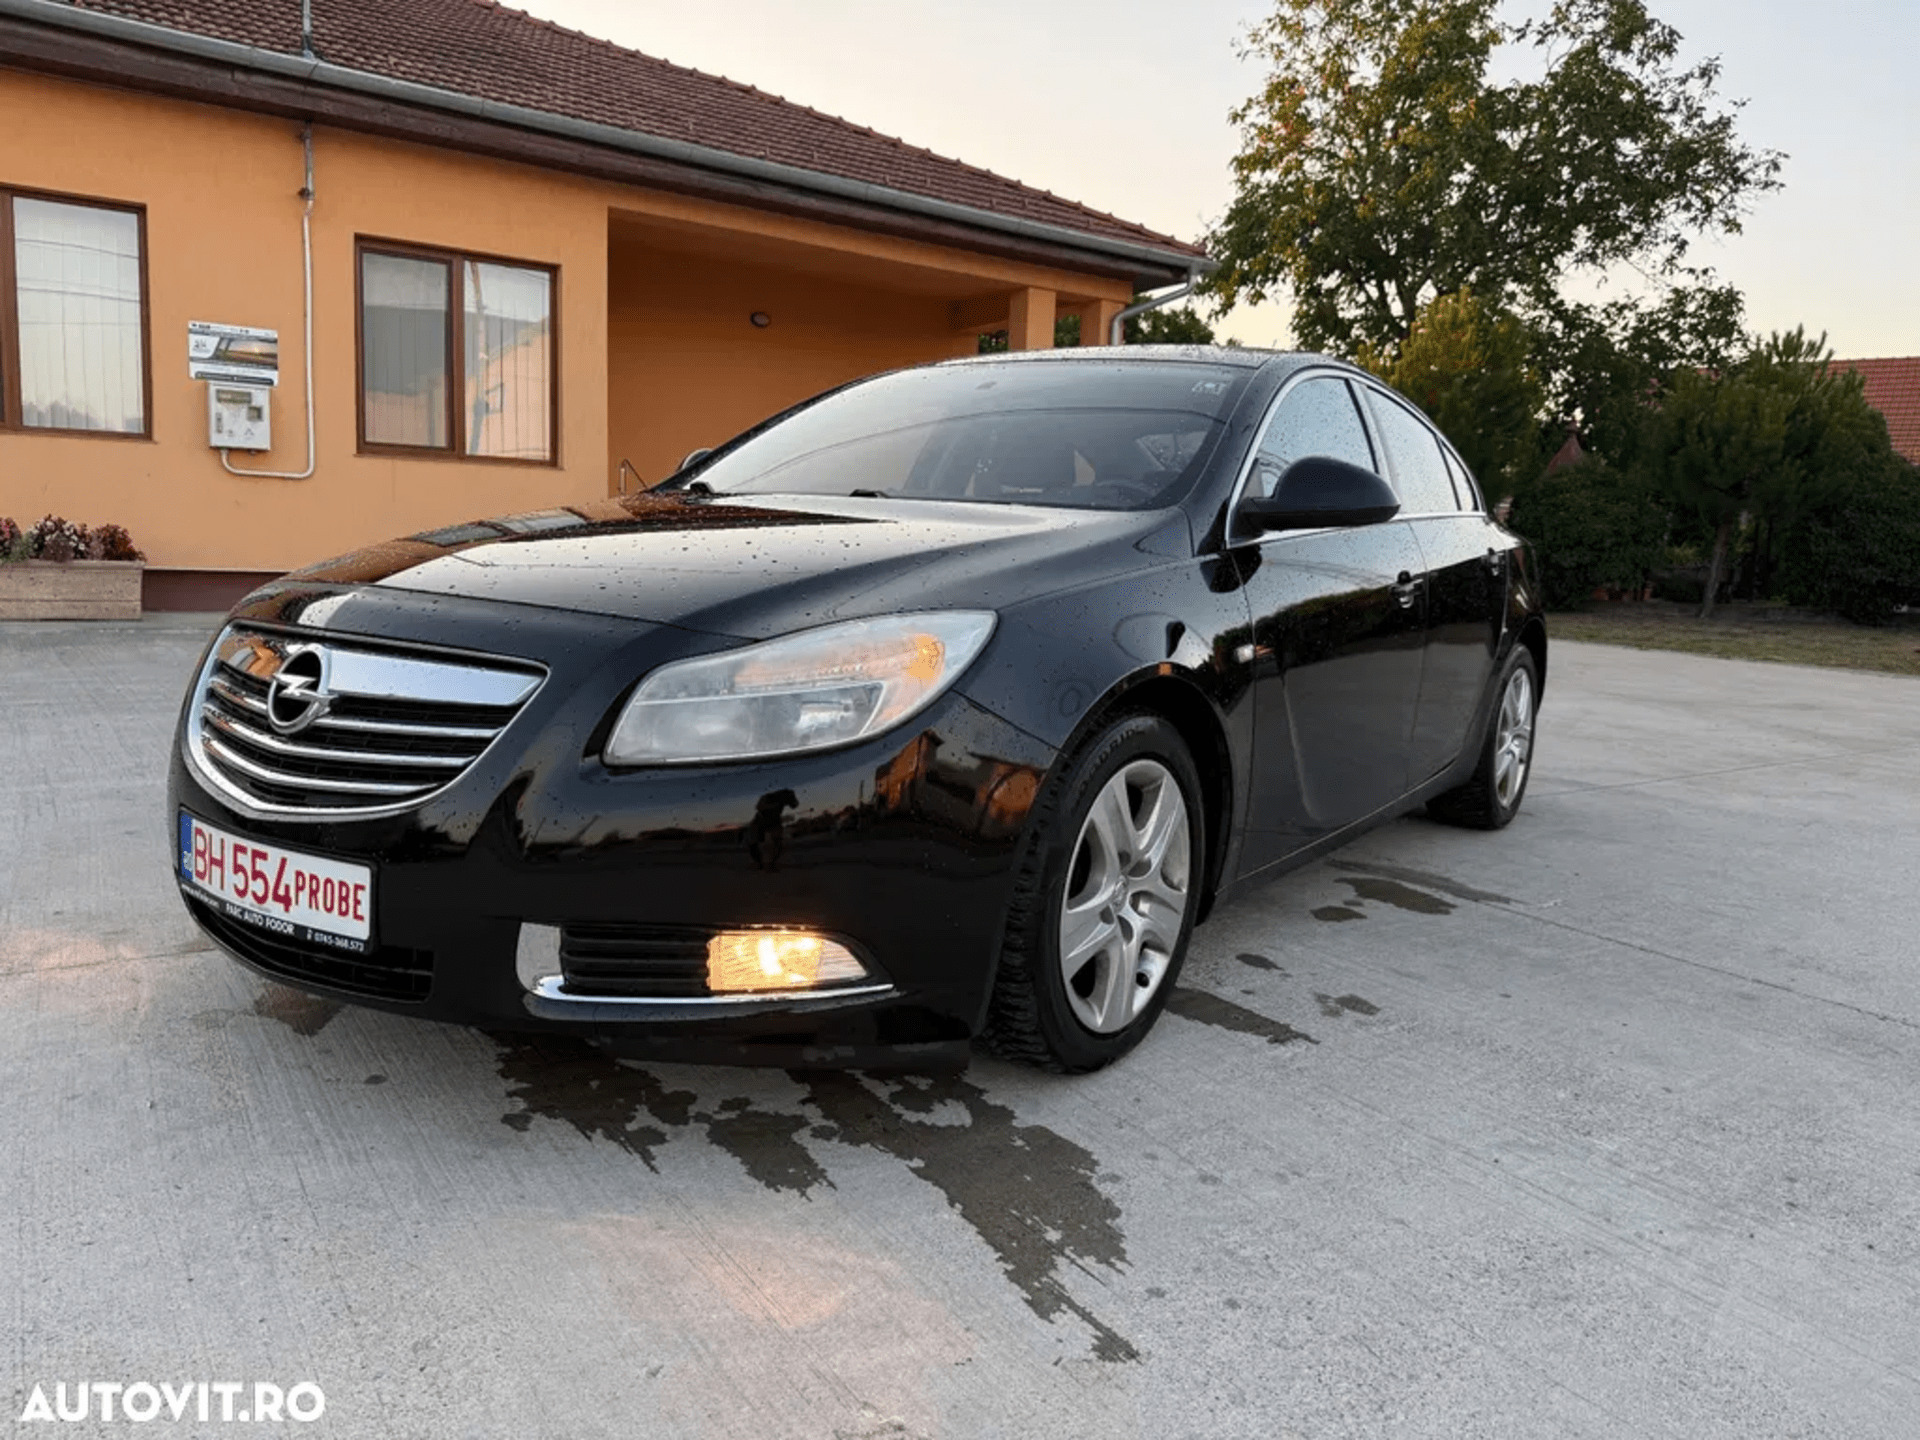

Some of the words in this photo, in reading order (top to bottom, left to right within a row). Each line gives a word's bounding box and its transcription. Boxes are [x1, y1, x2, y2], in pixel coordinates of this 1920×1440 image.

[194, 827, 226, 891] BH
[232, 843, 293, 913] 554
[294, 870, 367, 922] PROBE
[265, 917, 295, 936] FODOR
